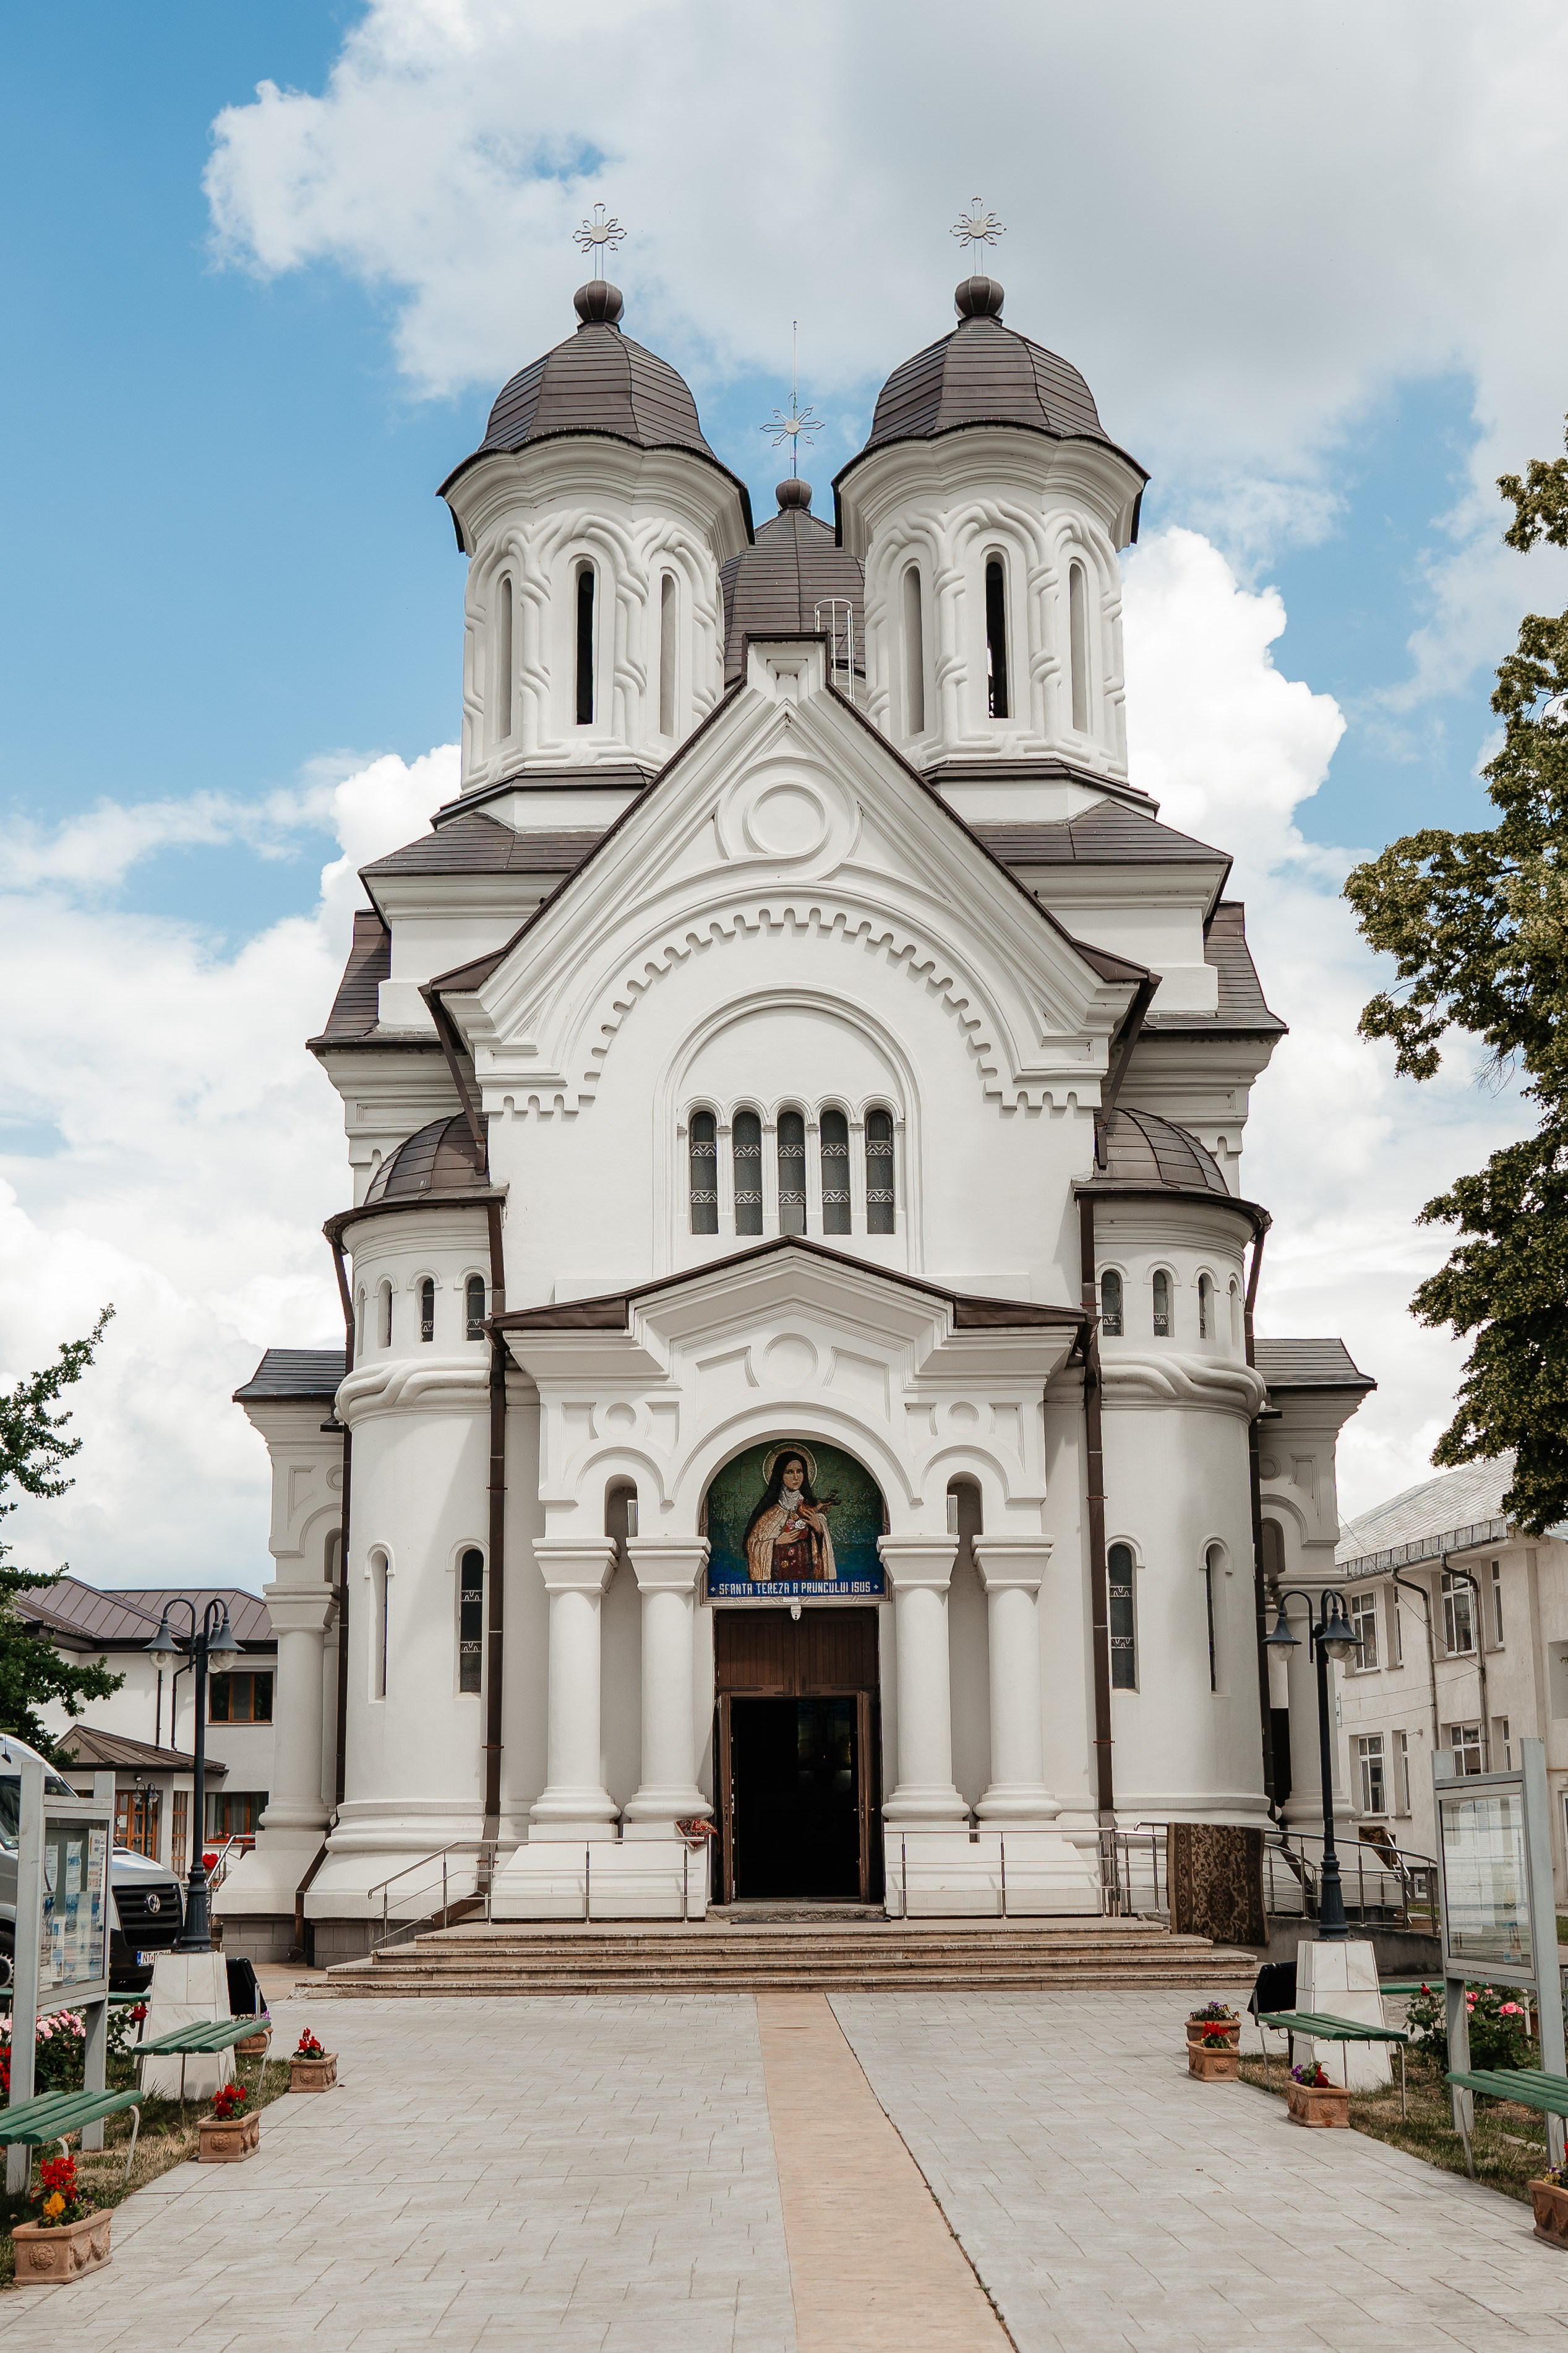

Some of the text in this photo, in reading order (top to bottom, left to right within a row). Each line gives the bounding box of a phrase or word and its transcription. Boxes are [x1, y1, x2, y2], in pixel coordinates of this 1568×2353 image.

[756, 1582, 789, 1594] TEREZA
[793, 1582, 798, 1593] A
[801, 1581, 848, 1593] PRUNCULUI
[851, 1581, 870, 1593] ISUS
[142, 1953, 152, 1963] NT
